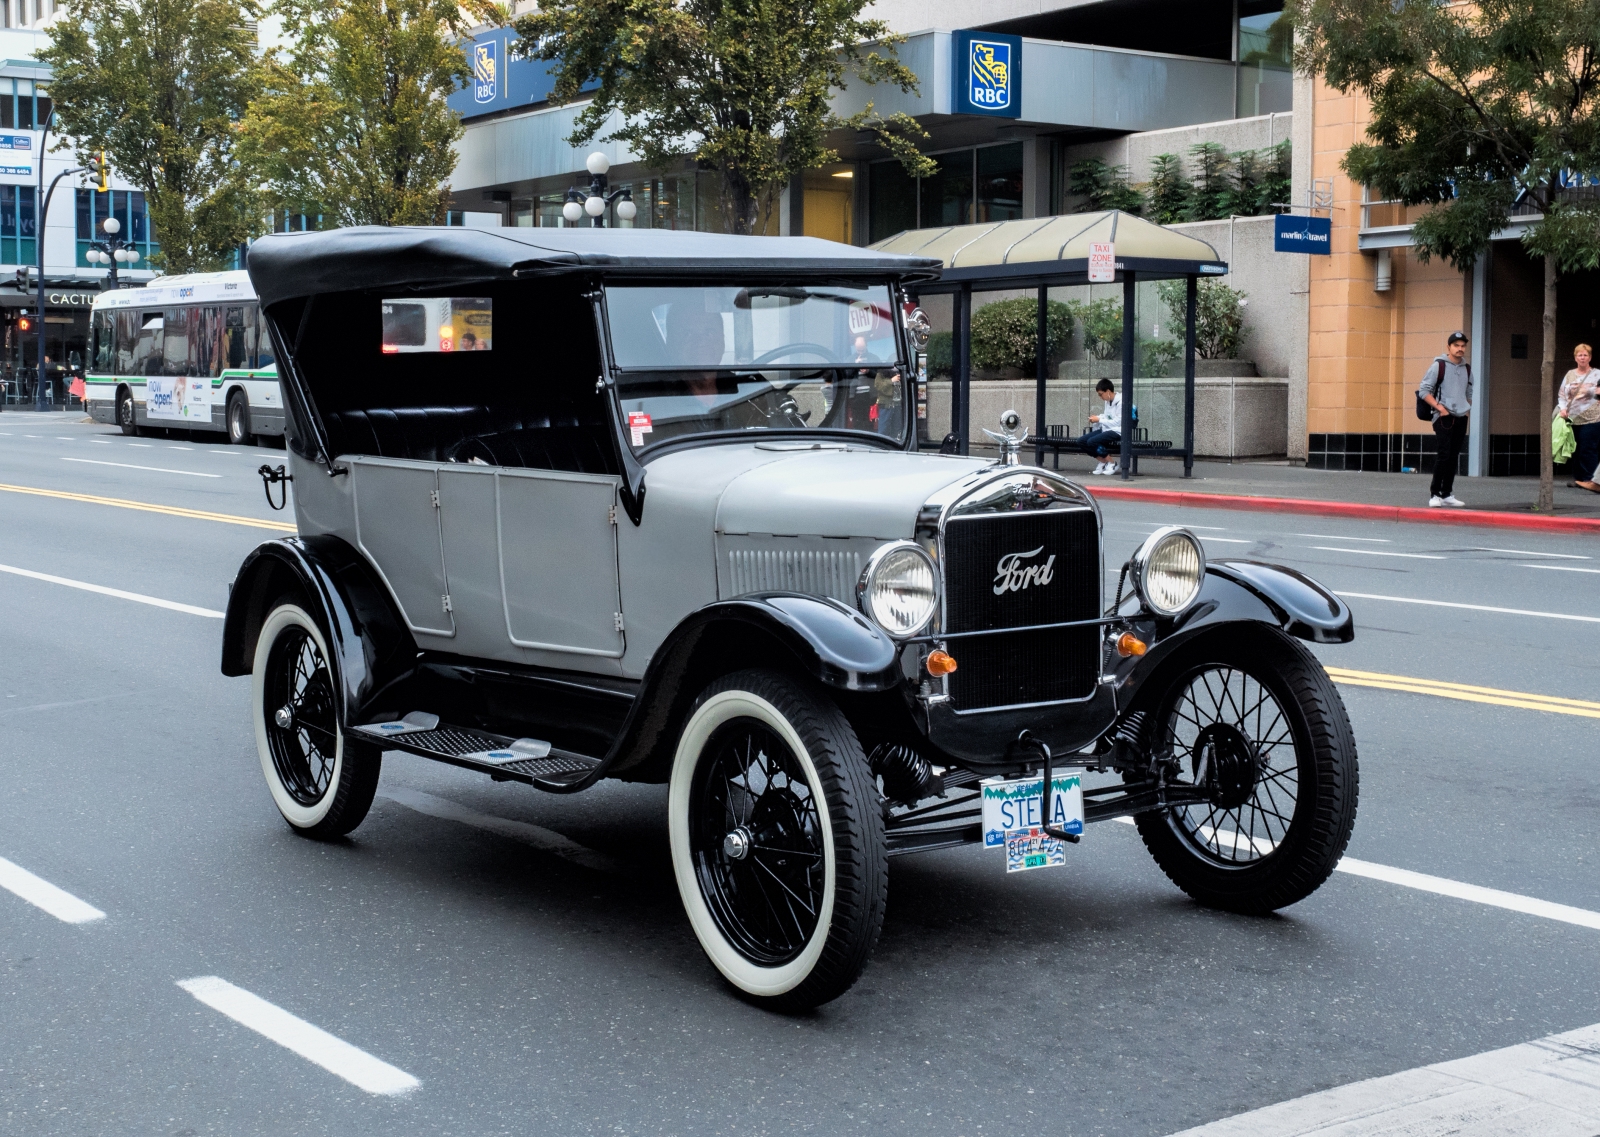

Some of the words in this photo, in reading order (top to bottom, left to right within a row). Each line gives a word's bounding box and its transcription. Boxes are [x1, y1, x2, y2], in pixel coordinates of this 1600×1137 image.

[477, 83, 494, 98] RBC
[974, 87, 1006, 104] RBC
[1281, 231, 1302, 240] marlin
[1309, 233, 1327, 242] travel
[1094, 244, 1110, 253] TAXI
[1091, 254, 1112, 262] ZONE
[850, 306, 870, 329] FIAT
[149, 380, 162, 393] now
[154, 390, 173, 409] open!
[993, 545, 1056, 595] Ford
